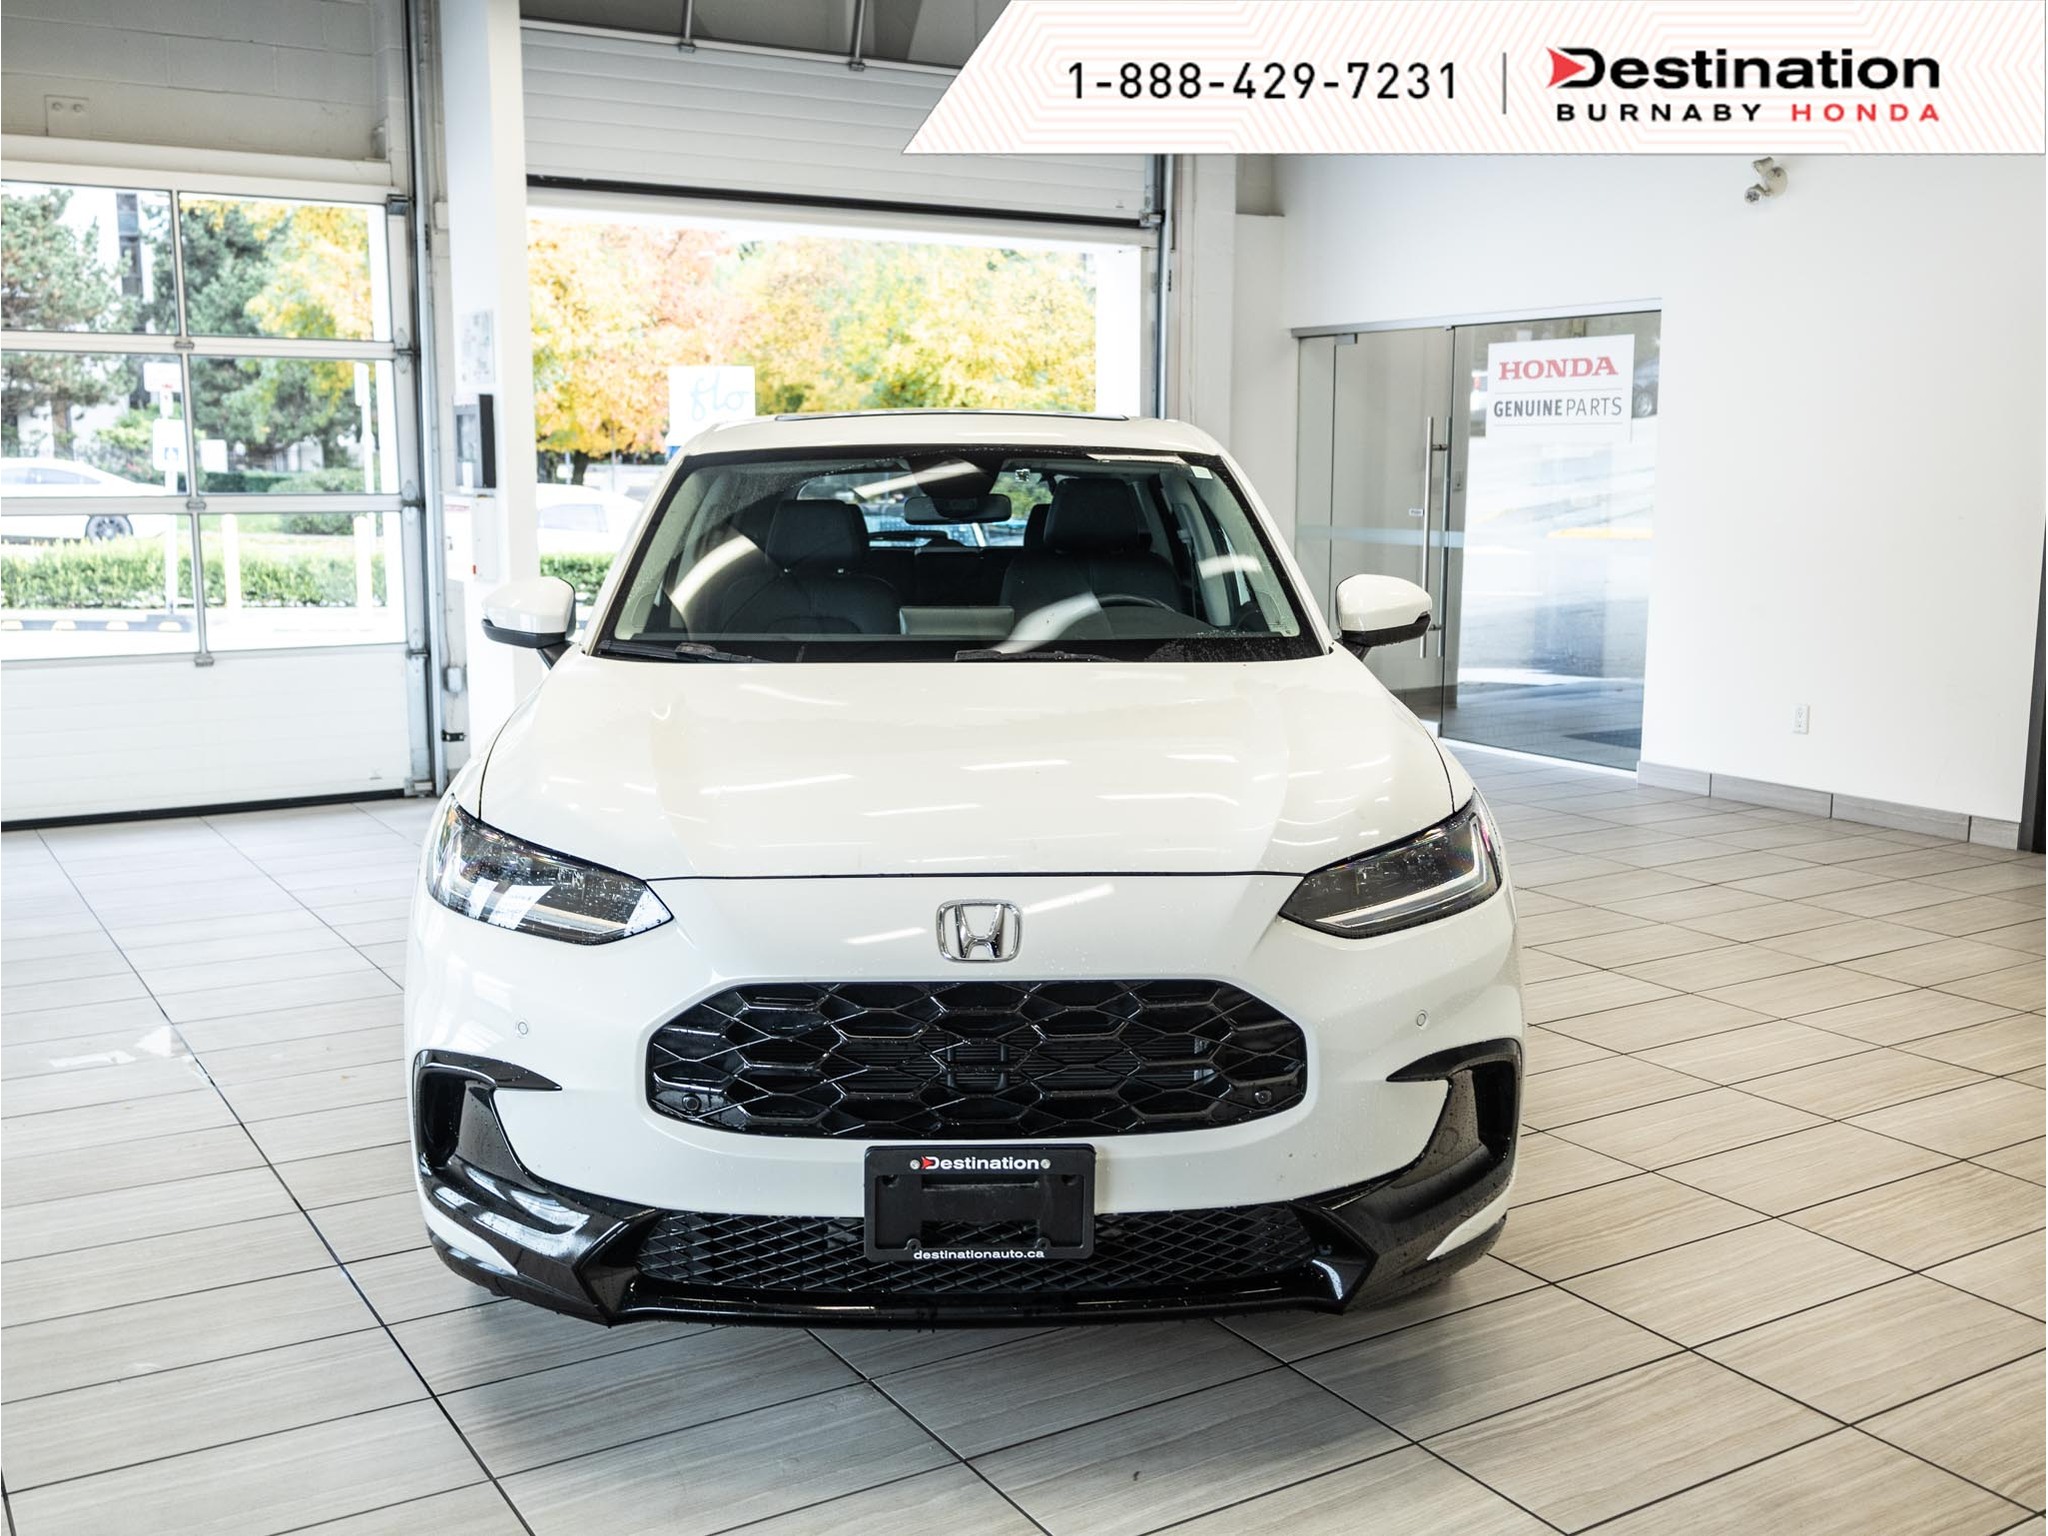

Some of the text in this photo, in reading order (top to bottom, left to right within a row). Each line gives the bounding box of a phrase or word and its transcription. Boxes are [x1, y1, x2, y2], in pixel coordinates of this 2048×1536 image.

[1499, 356, 1619, 381] HONDA
[1493, 396, 1622, 418] GENUINE PARTS
[921, 1156, 1040, 1171] Destination
[912, 1249, 1046, 1261] destinationauto.ca
